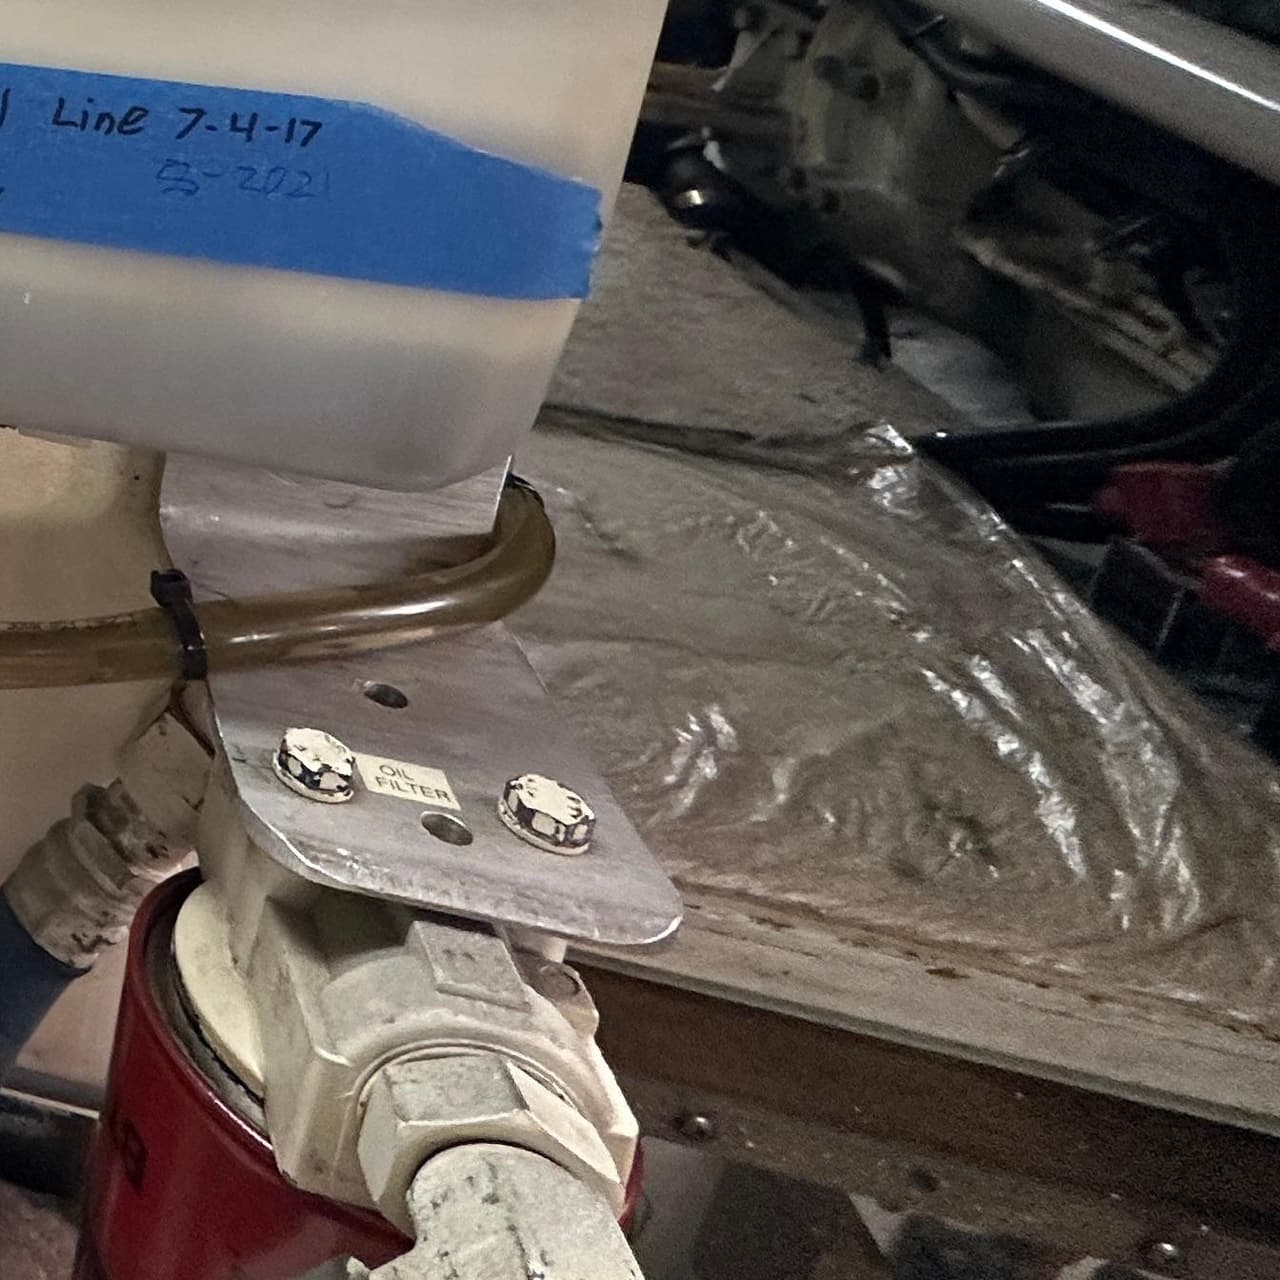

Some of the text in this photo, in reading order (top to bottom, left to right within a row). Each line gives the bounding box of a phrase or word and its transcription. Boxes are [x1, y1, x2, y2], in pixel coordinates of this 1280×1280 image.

[51, 97, 149, 136] Line
[175, 106, 323, 148] 7-4-17
[379, 763, 415, 781] OIL
[375, 775, 452, 803] FILTER
